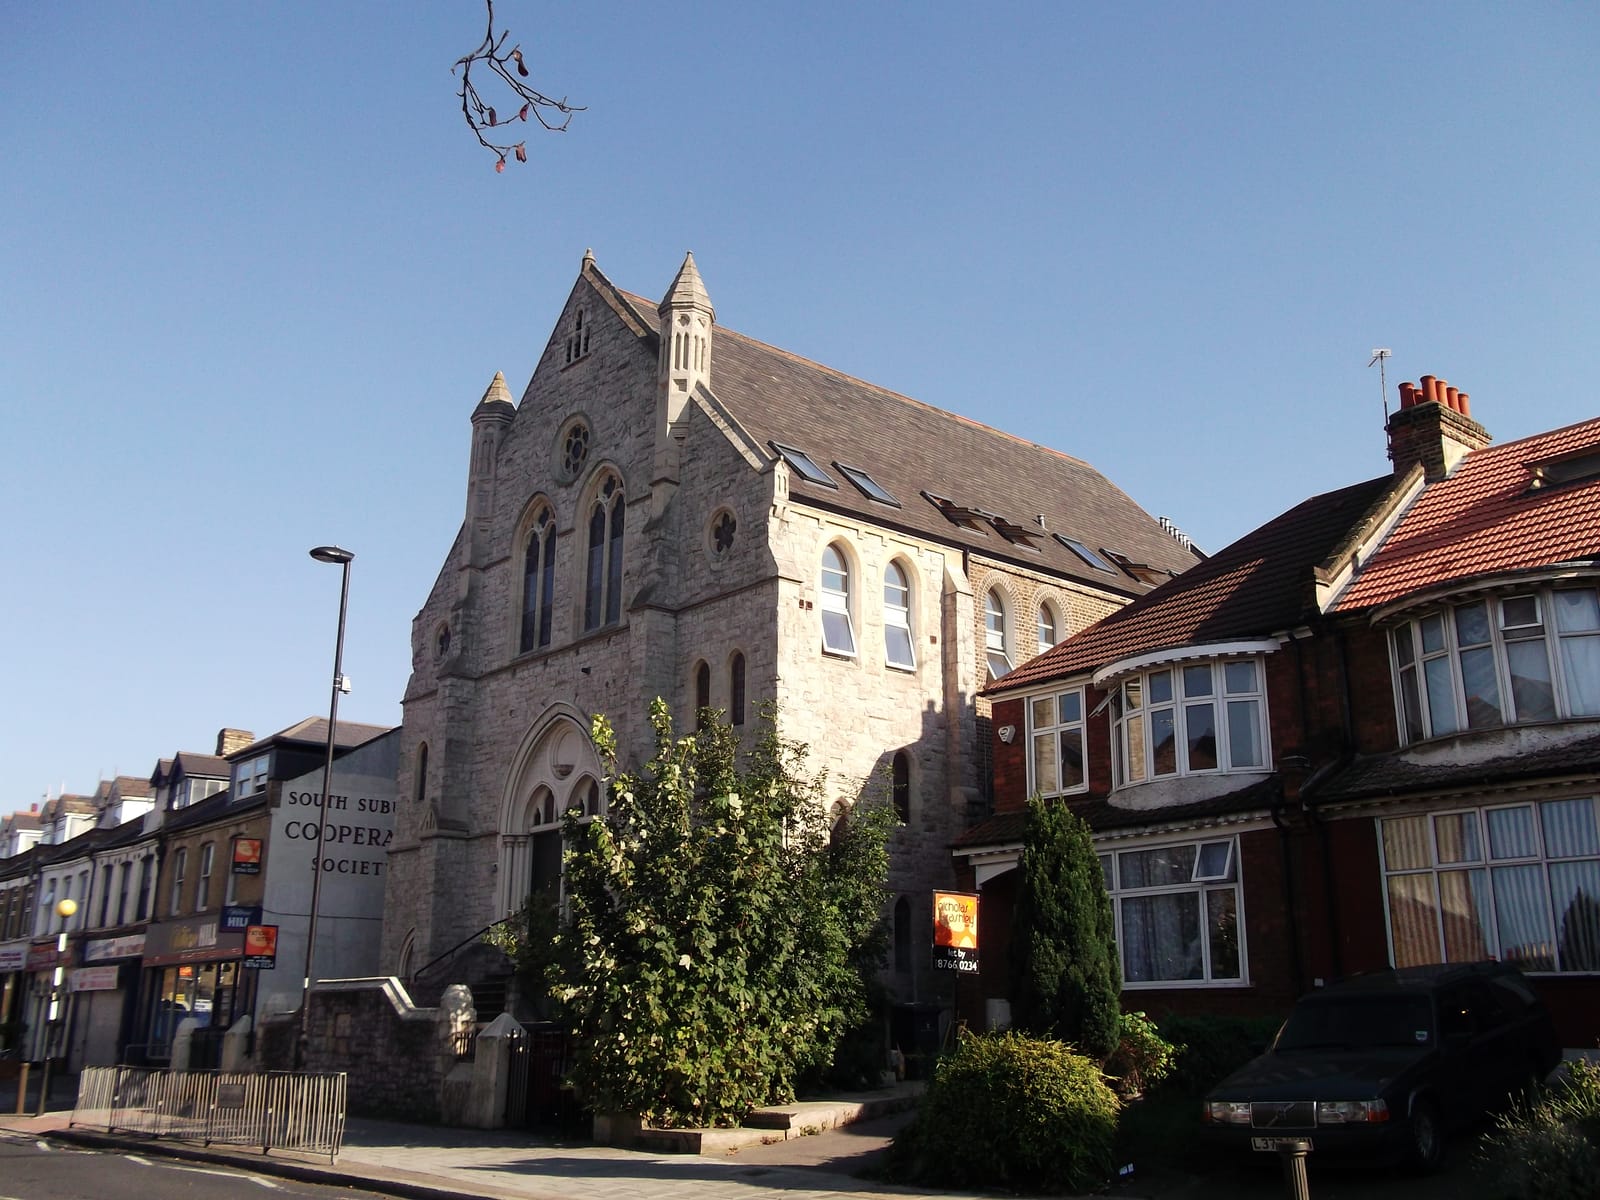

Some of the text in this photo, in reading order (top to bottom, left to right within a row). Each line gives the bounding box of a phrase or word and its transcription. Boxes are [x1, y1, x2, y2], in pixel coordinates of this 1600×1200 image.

[288, 791, 396, 814] SOUTH SUB
[311, 857, 389, 876] SOCIET
[957, 948, 966, 959] by
[959, 960, 977, 971] 0234
